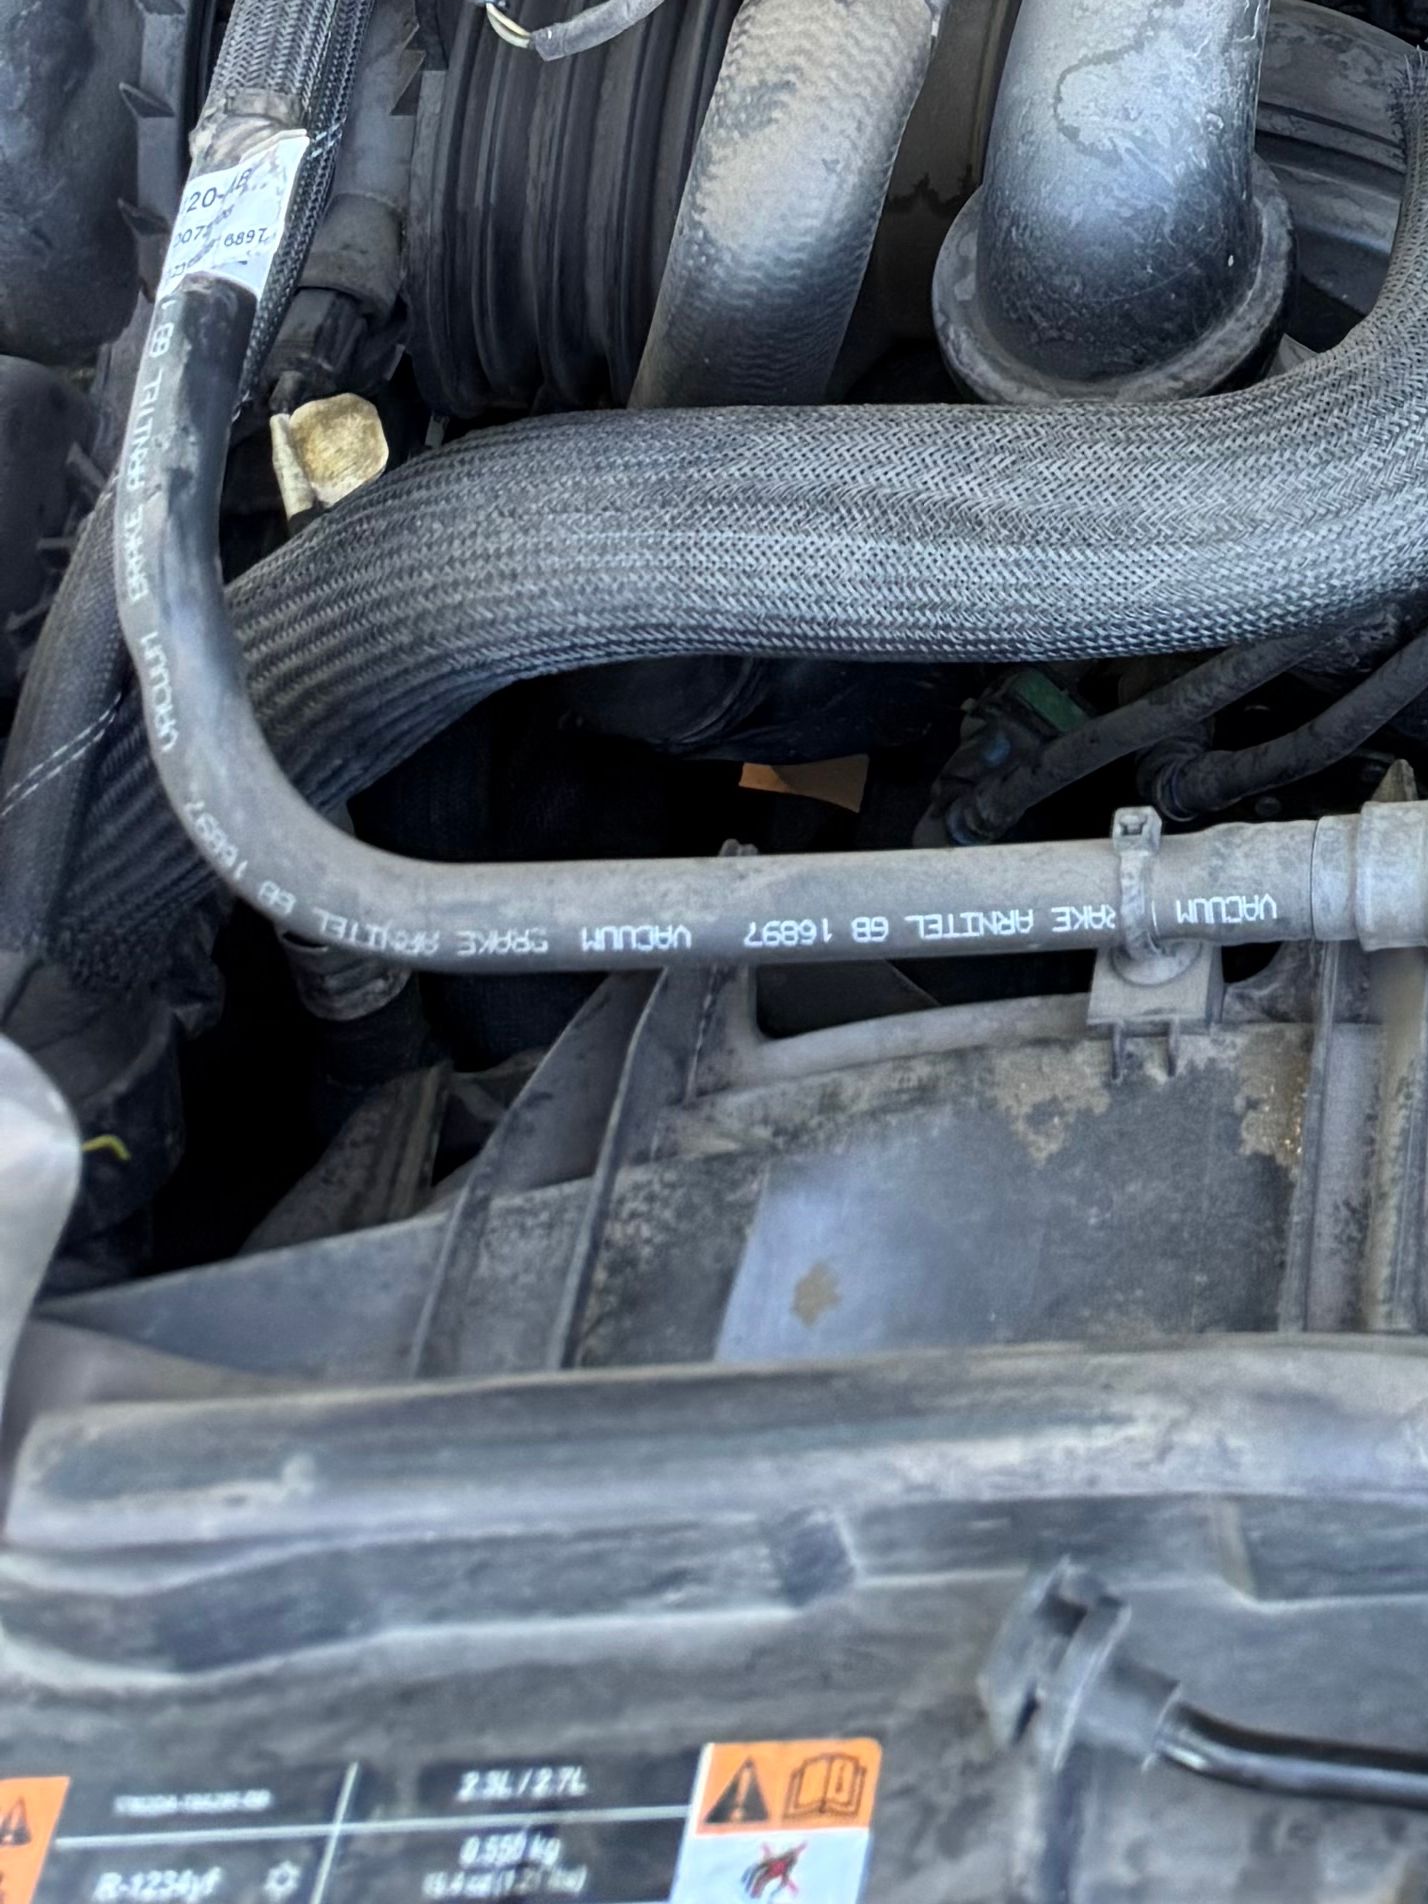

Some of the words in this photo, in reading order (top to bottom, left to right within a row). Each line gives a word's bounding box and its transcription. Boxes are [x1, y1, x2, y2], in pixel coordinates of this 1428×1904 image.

[126, 368, 164, 493] ARNITEL
[124, 504, 150, 604] BRAKE
[140, 630, 178, 752] VACUUM
[904, 908, 1034, 938] ARNITEL
[1051, 900, 1157, 932] RAKE
[1176, 894, 1277, 923] VACUUM
[582, 923, 692, 951] VACUUM
[743, 918, 832, 946] 16897
